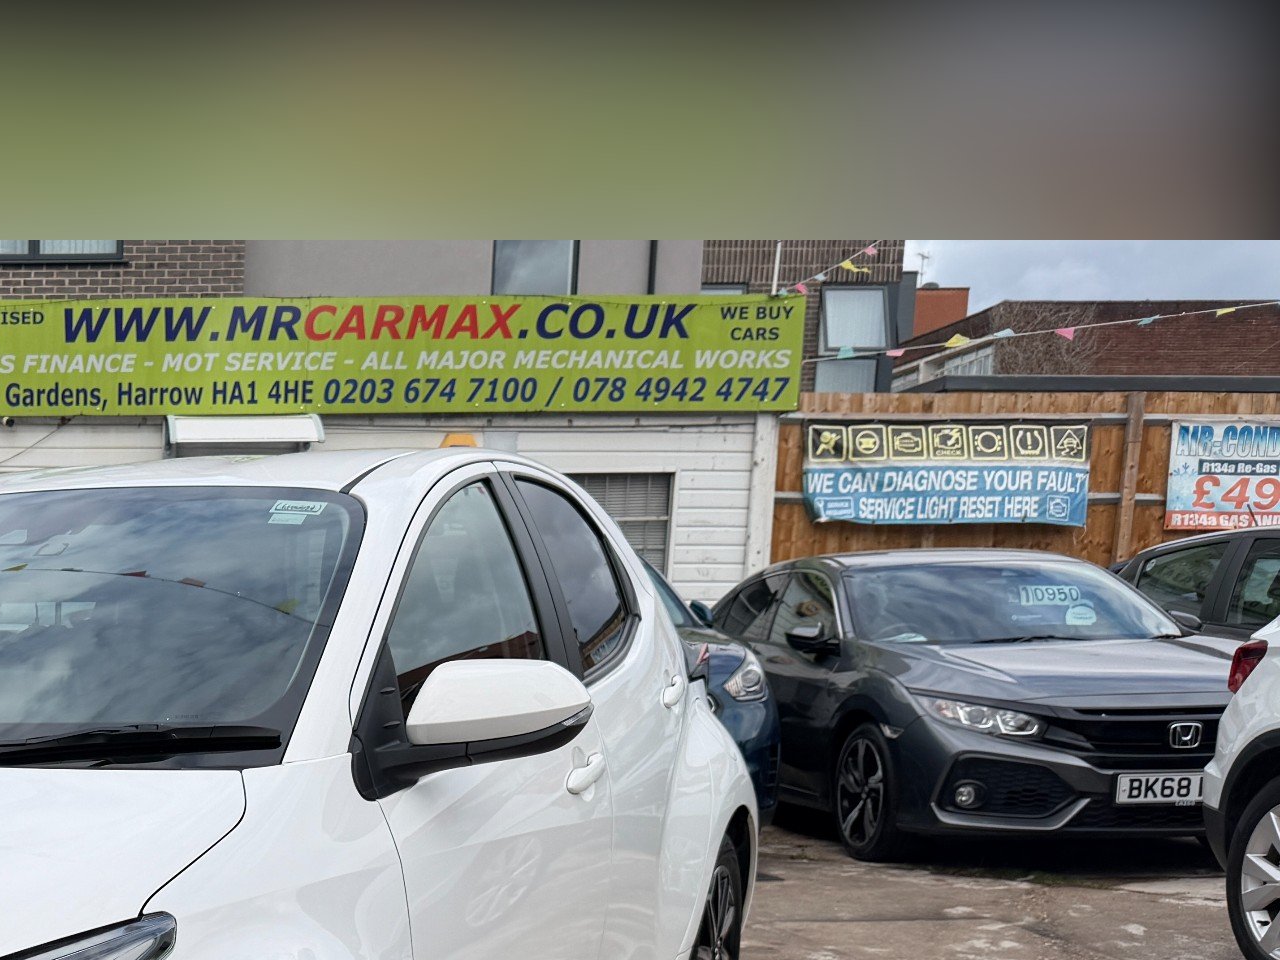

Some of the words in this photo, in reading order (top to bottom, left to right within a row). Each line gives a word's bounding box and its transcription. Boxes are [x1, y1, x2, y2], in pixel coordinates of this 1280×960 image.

[64, 303, 698, 343] WWW.MRCARMAX.CO.UK
[721, 306, 749, 320] WE
[756, 306, 794, 320] BUY
[730, 327, 780, 341] CARS
[22, 353, 137, 374] FINANCE
[162, 352, 219, 373] MOT
[224, 351, 337, 372] SERVICE
[361, 351, 408, 371] ALL
[416, 350, 507, 371] MAJOR
[513, 349, 684, 370] MECHANICAL
[695, 349, 792, 369] WORKS
[5, 382, 108, 412] Gardens,
[117, 381, 204, 406] Harrow
[212, 380, 258, 405] HA1
[268, 380, 314, 404] 4HE
[323, 378, 395, 404] 0203
[404, 378, 456, 403] 674
[466, 377, 538, 403] 7100
[573, 377, 626, 403] 078
[635, 377, 707, 402] 4942
[715, 377, 790, 402] 4747
[1202, 462, 1235, 473] R134a
[1237, 462, 1277, 473] Re-Gas
[807, 472, 835, 493] WE
[837, 471, 879, 493] CAN
[882, 469, 979, 492] DIAGNOSE
[983, 470, 1032, 491] YOUR
[1037, 470, 1086, 493] FAULT
[858, 497, 915, 520] SERVICE
[916, 496, 957, 519] LIGHT
[959, 496, 1002, 518] RESET
[1004, 496, 1040, 518] HERE
[1171, 513, 1217, 526] R134a
[1219, 514, 1249, 527] GAS
[1127, 777, 1192, 799] BK68
